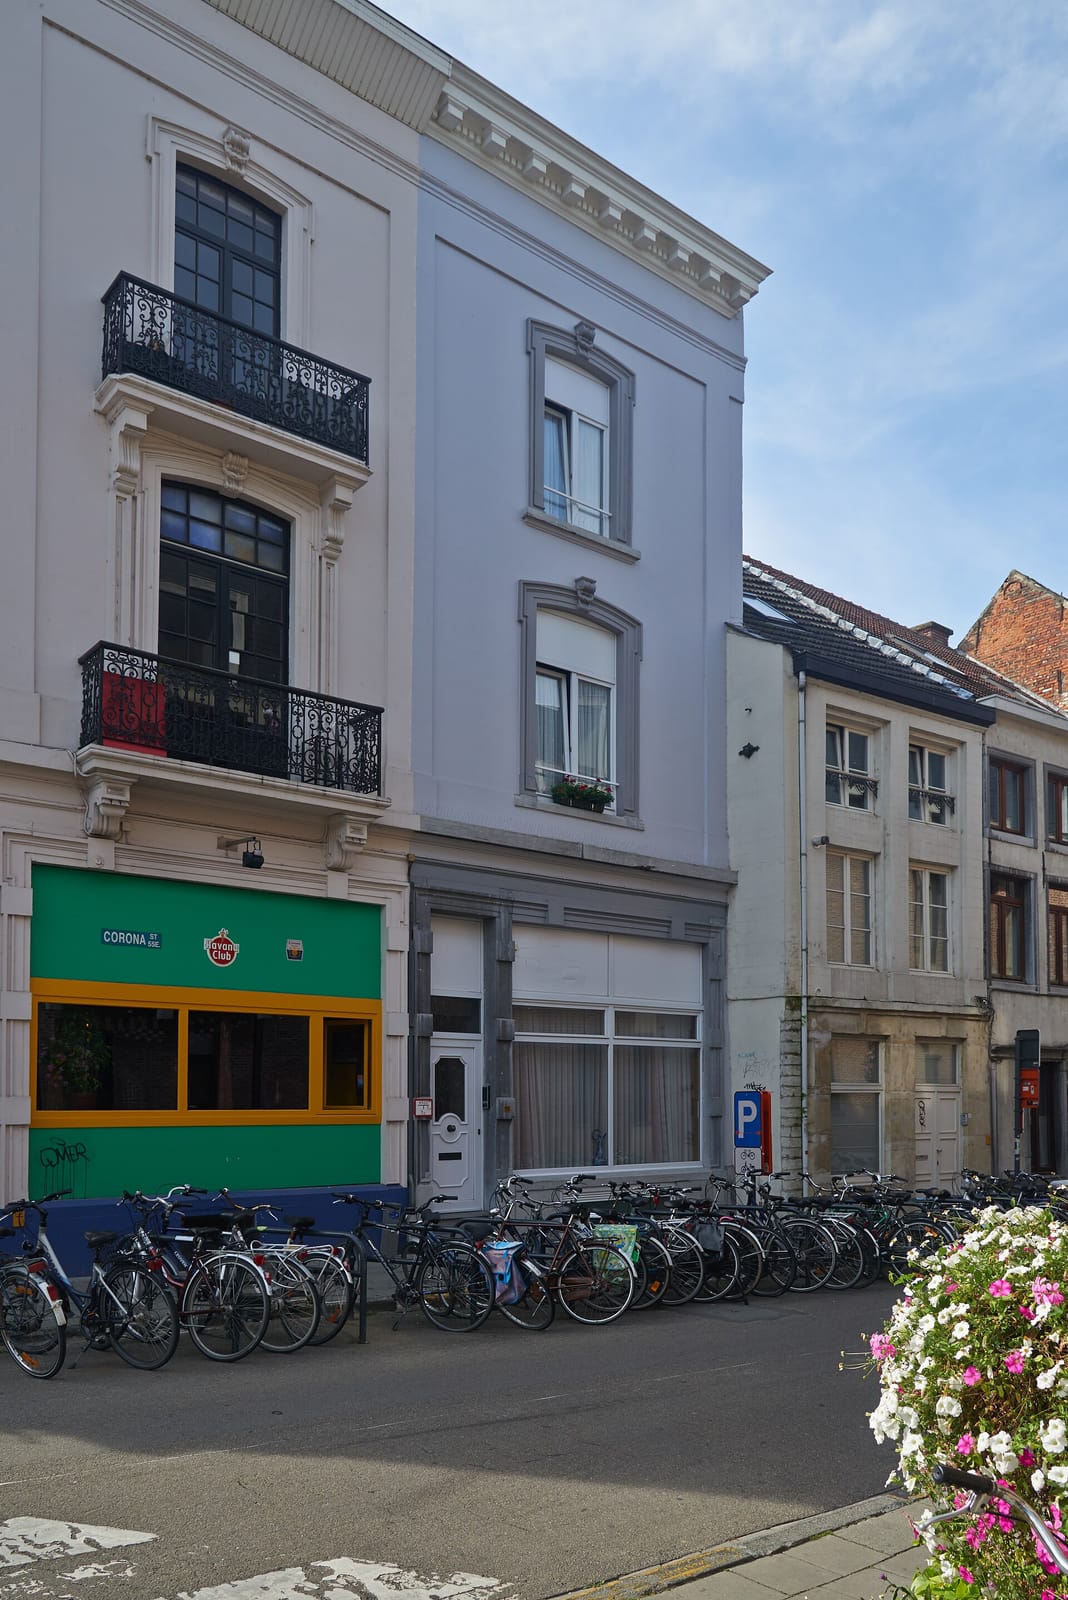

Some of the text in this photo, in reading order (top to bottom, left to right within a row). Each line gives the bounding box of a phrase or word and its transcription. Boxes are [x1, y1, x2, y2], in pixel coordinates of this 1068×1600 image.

[103, 930, 158, 945] CORONA ST
[204, 938, 240, 954] Havana
[212, 950, 232, 961] Club
[737, 1100, 758, 1139] P
